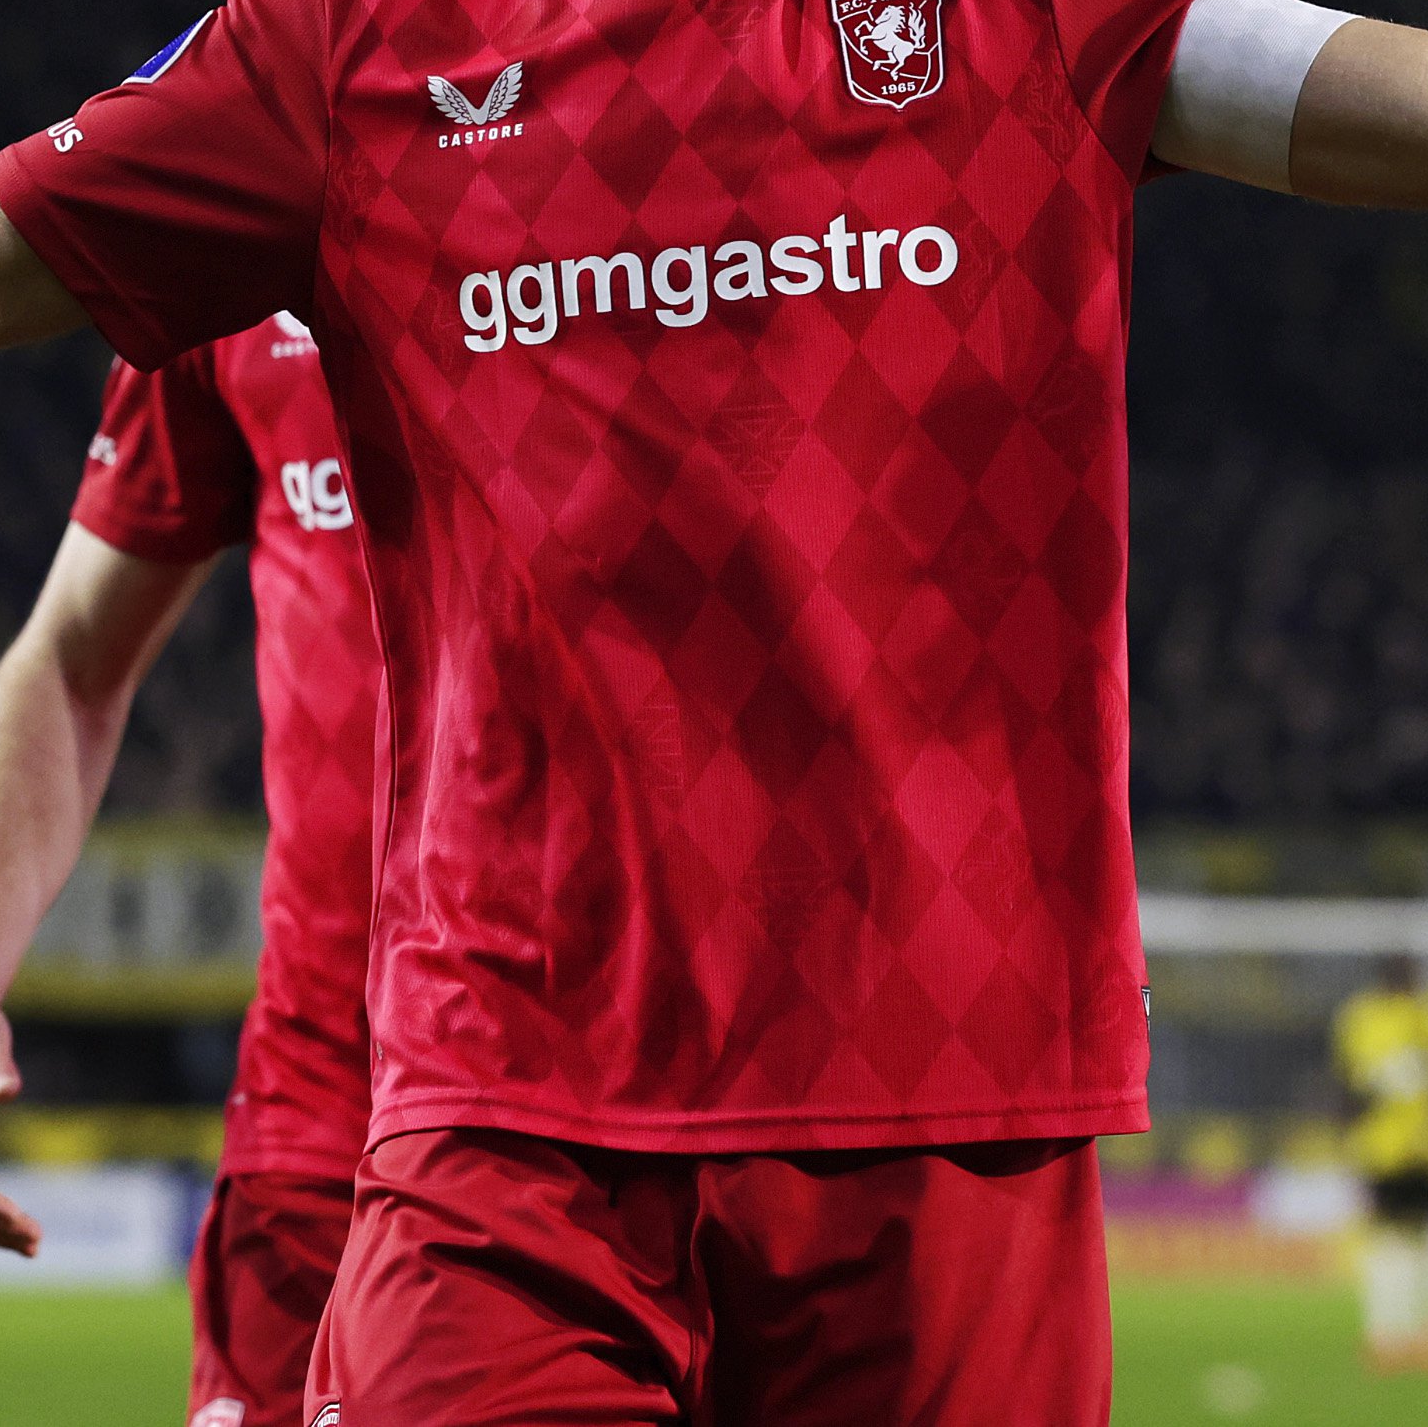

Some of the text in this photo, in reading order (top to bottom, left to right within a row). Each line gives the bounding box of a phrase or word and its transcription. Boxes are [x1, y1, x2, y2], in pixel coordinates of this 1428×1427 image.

[881, 82, 915, 95] 1965
[438, 122, 523, 148] CASTORE
[459, 213, 959, 353] ggmgastro
